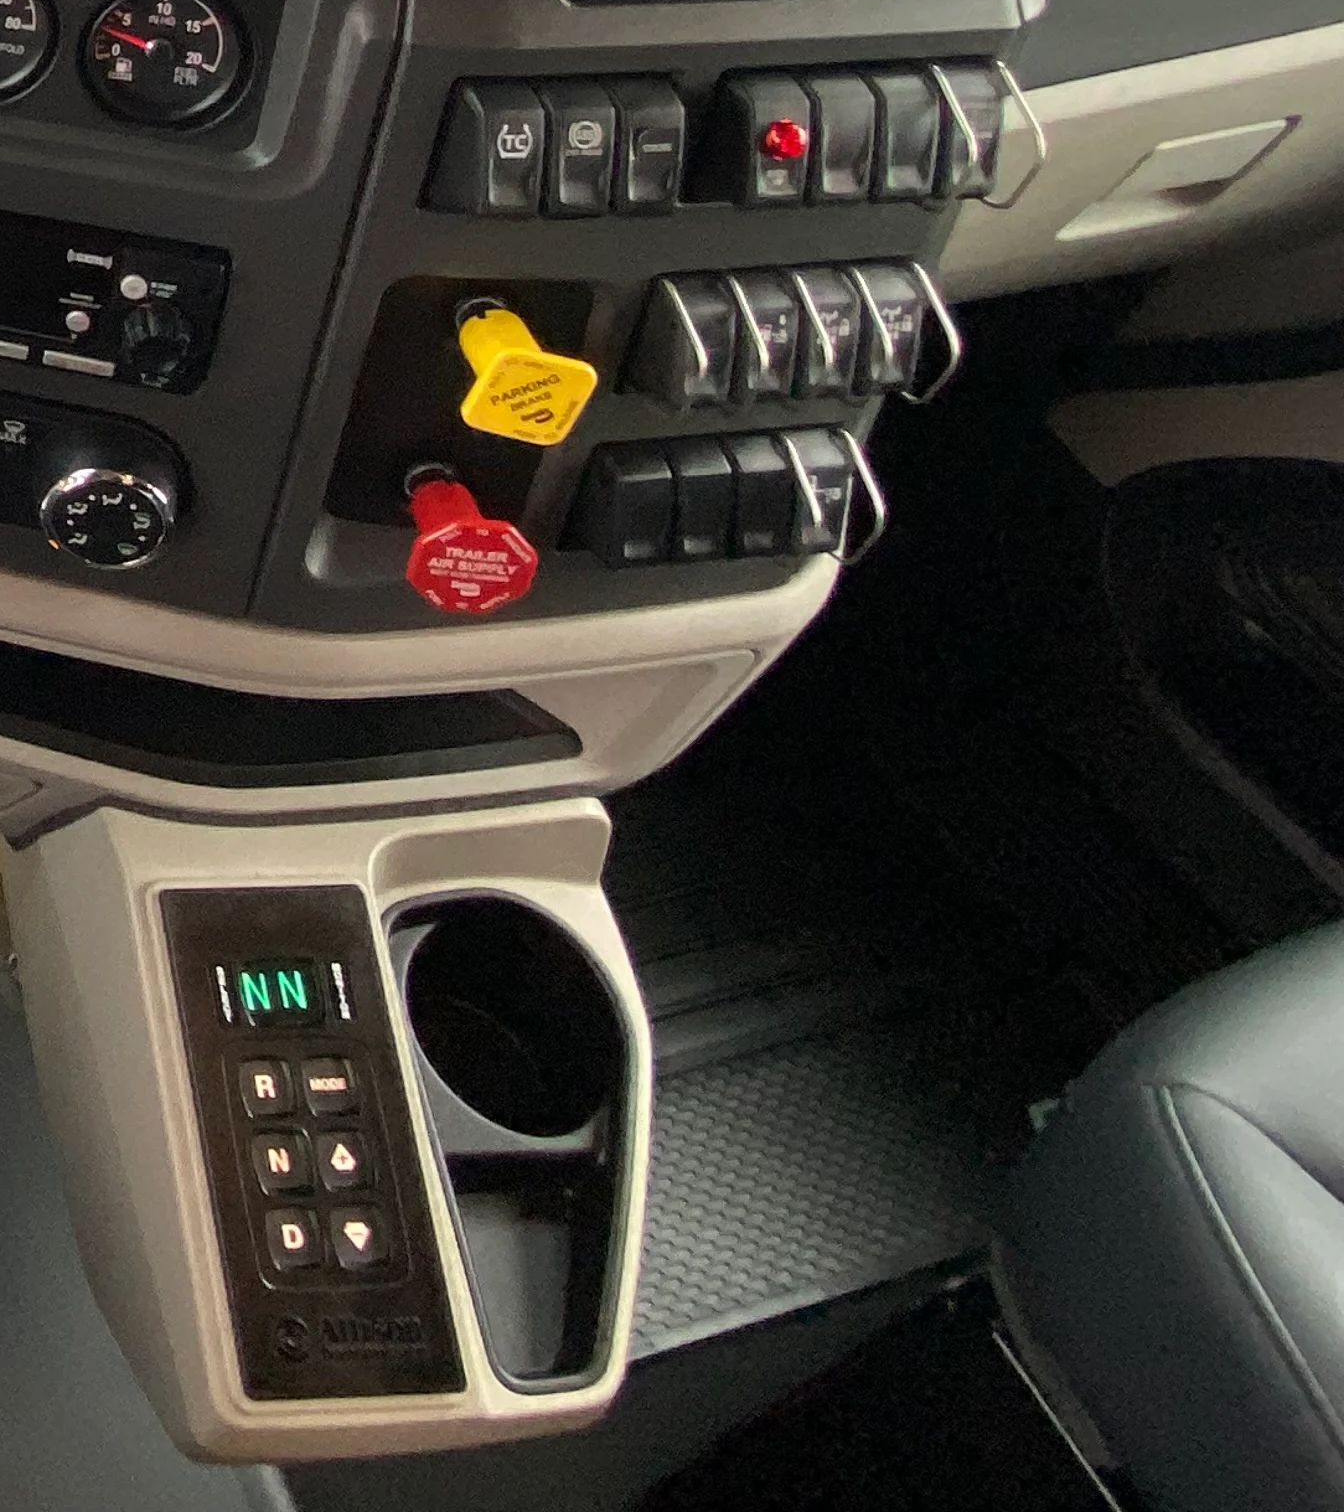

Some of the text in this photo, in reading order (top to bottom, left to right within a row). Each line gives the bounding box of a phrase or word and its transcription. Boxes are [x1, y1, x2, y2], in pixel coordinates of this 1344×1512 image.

[156, 2, 173, 15] 10
[122, 13, 201, 33] 5 15
[185, 51, 203, 65] 20
[503, 134, 526, 150] TC
[490, 373, 561, 407] PARKING
[446, 547, 509, 563] TRAILER
[457, 560, 520, 575] SUPPLY
[254, 1073, 276, 1100] R
[310, 1077, 347, 1092] MODE
[267, 1148, 290, 1174] N
[281, 1223, 305, 1251] D
